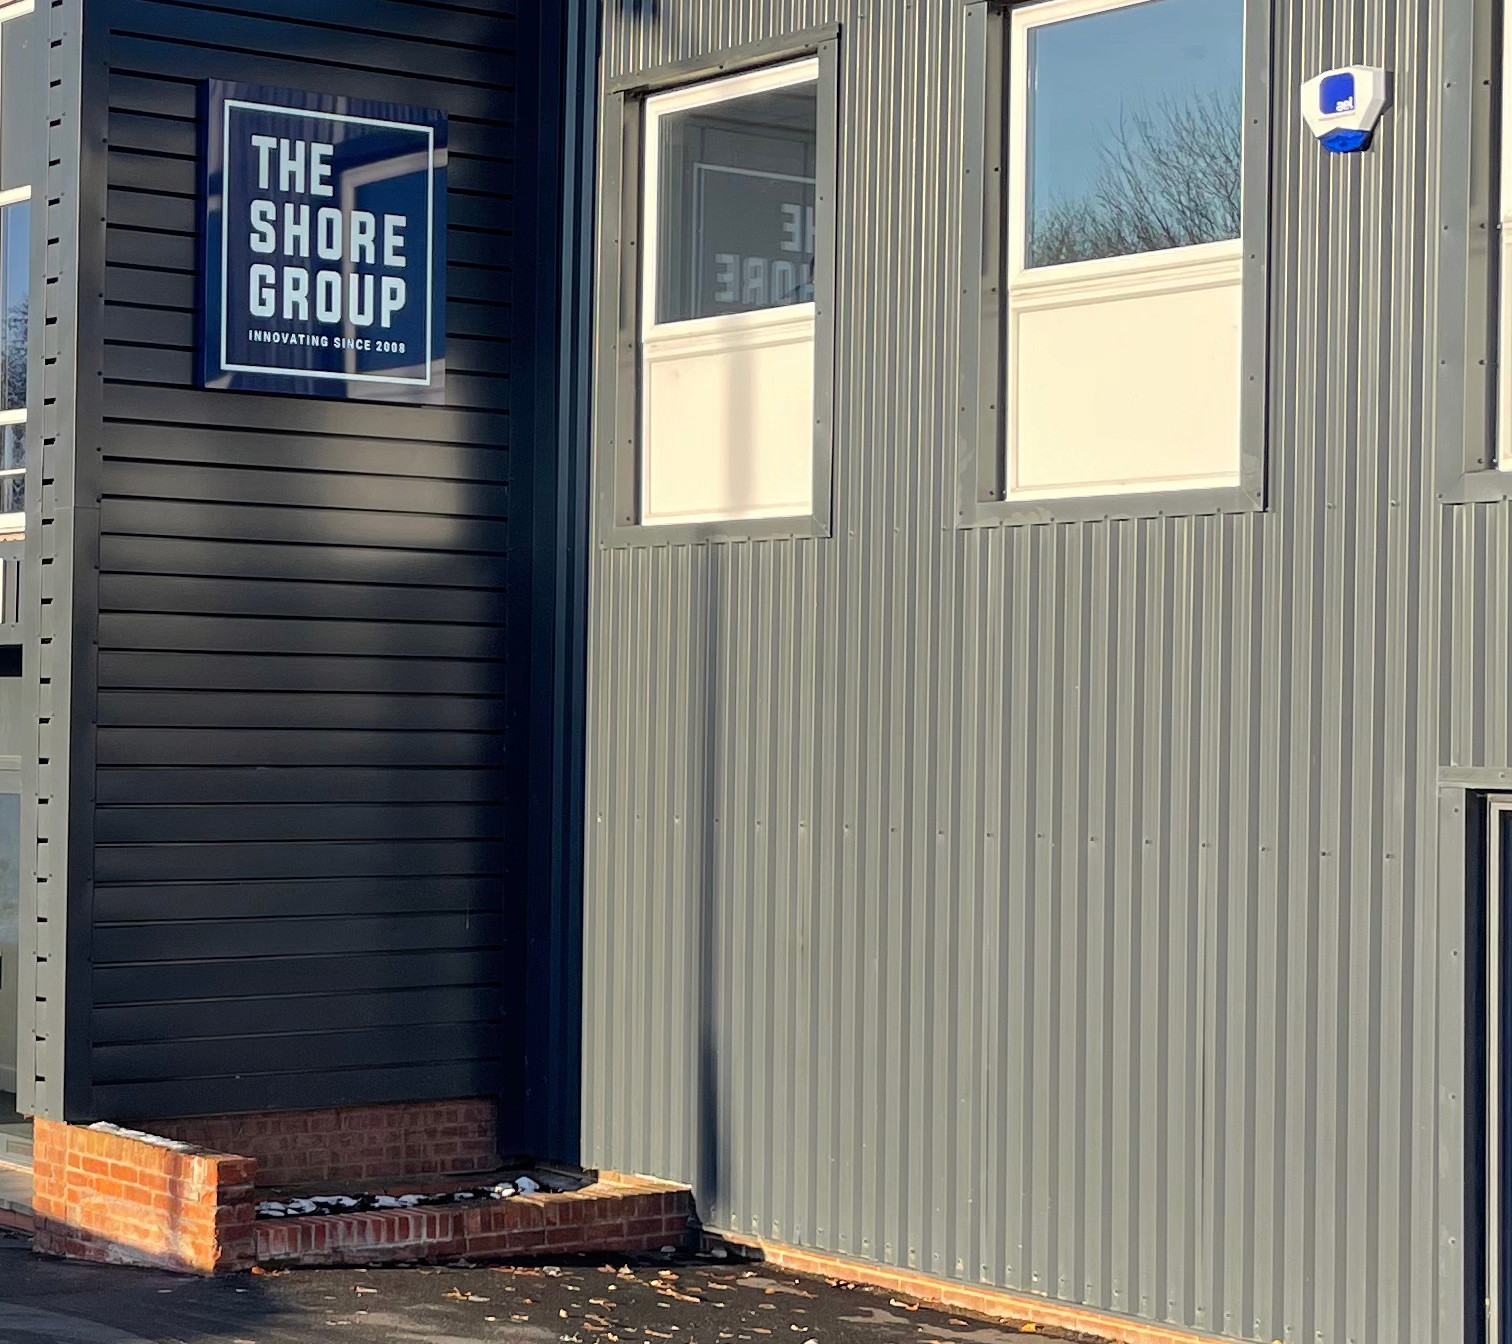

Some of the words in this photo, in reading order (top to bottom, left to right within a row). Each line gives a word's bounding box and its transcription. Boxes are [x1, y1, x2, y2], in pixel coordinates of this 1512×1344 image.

[251, 134, 334, 197] THE
[249, 199, 407, 268] SHORE
[248, 263, 407, 329] GROUP
[248, 329, 329, 348] INNOVATING
[333, 337, 372, 351] SINCE
[375, 340, 406, 354] 2008
